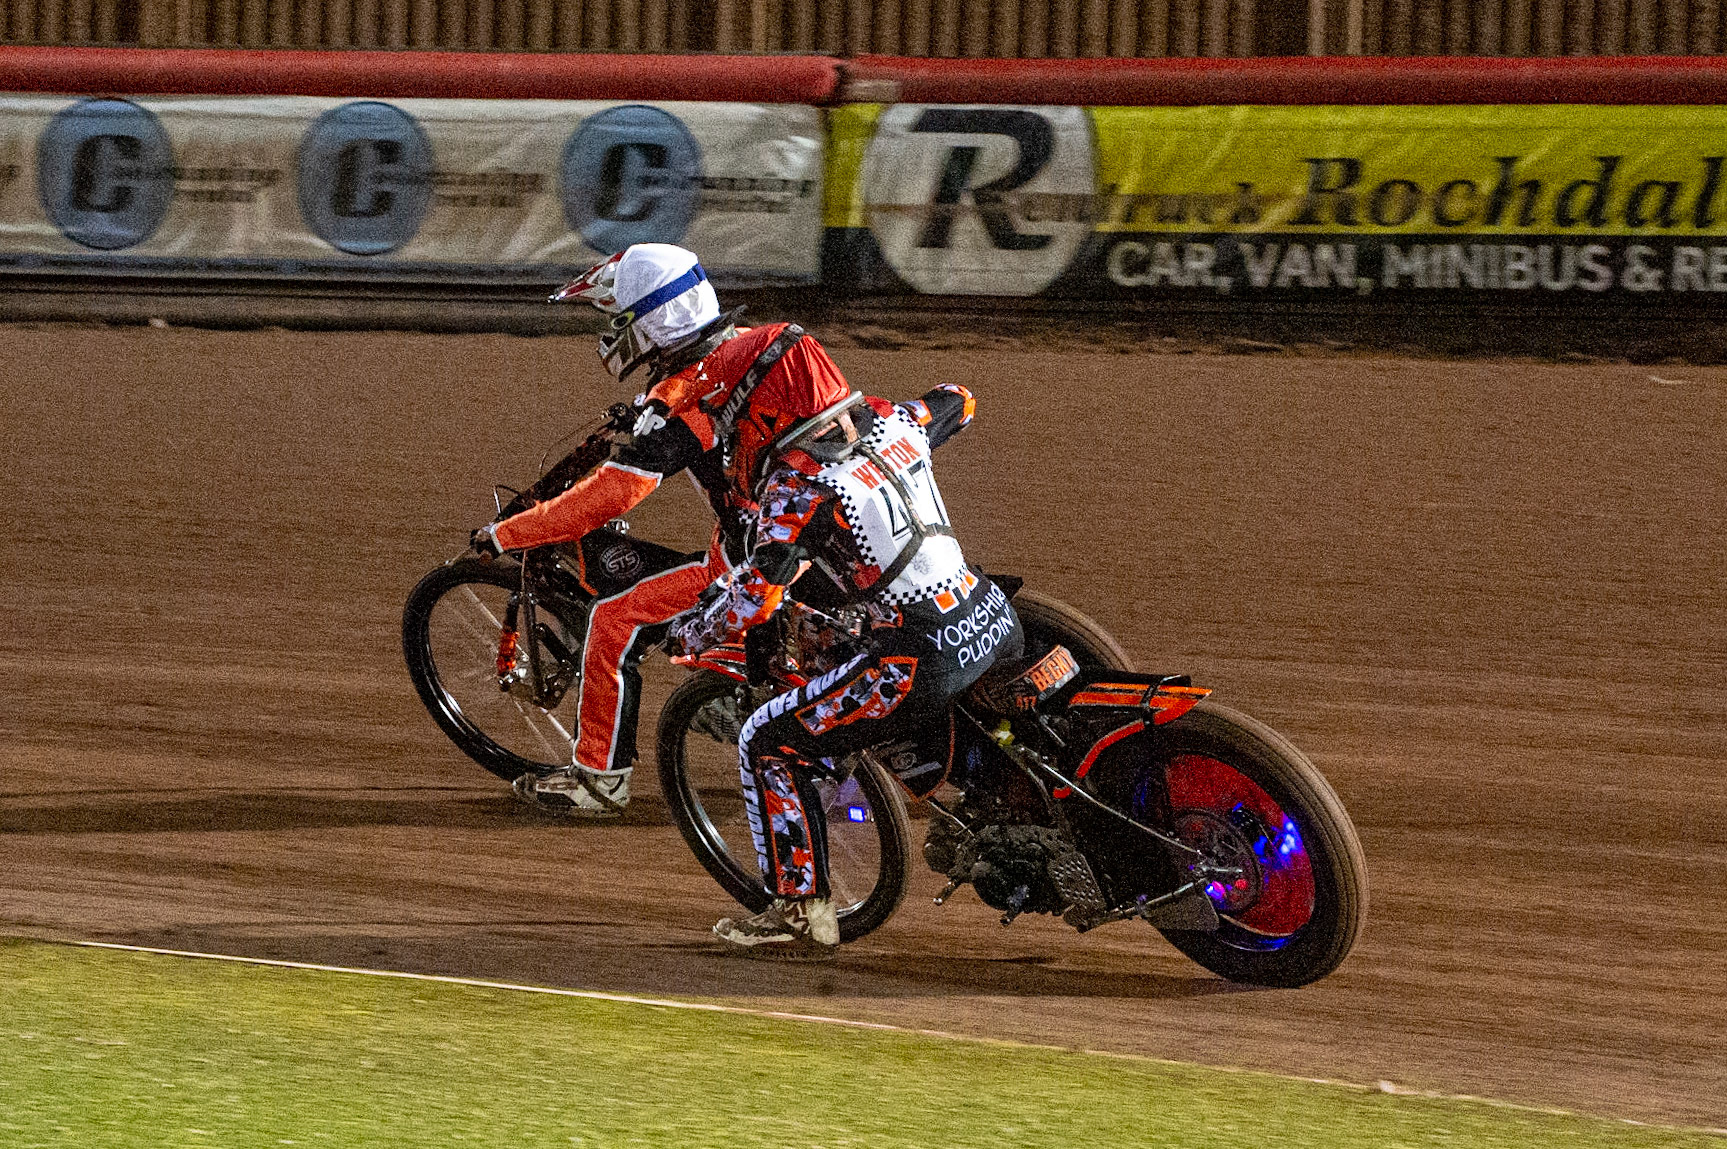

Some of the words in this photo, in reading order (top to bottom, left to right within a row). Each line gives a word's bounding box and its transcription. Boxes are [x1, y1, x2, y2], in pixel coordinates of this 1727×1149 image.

[1381, 243, 1614, 292] MINIBUS
[1620, 244, 1664, 292] &
[851, 437, 921, 490] WETON
[608, 550, 636, 572] STS
[926, 580, 1006, 650] YORKSHIR
